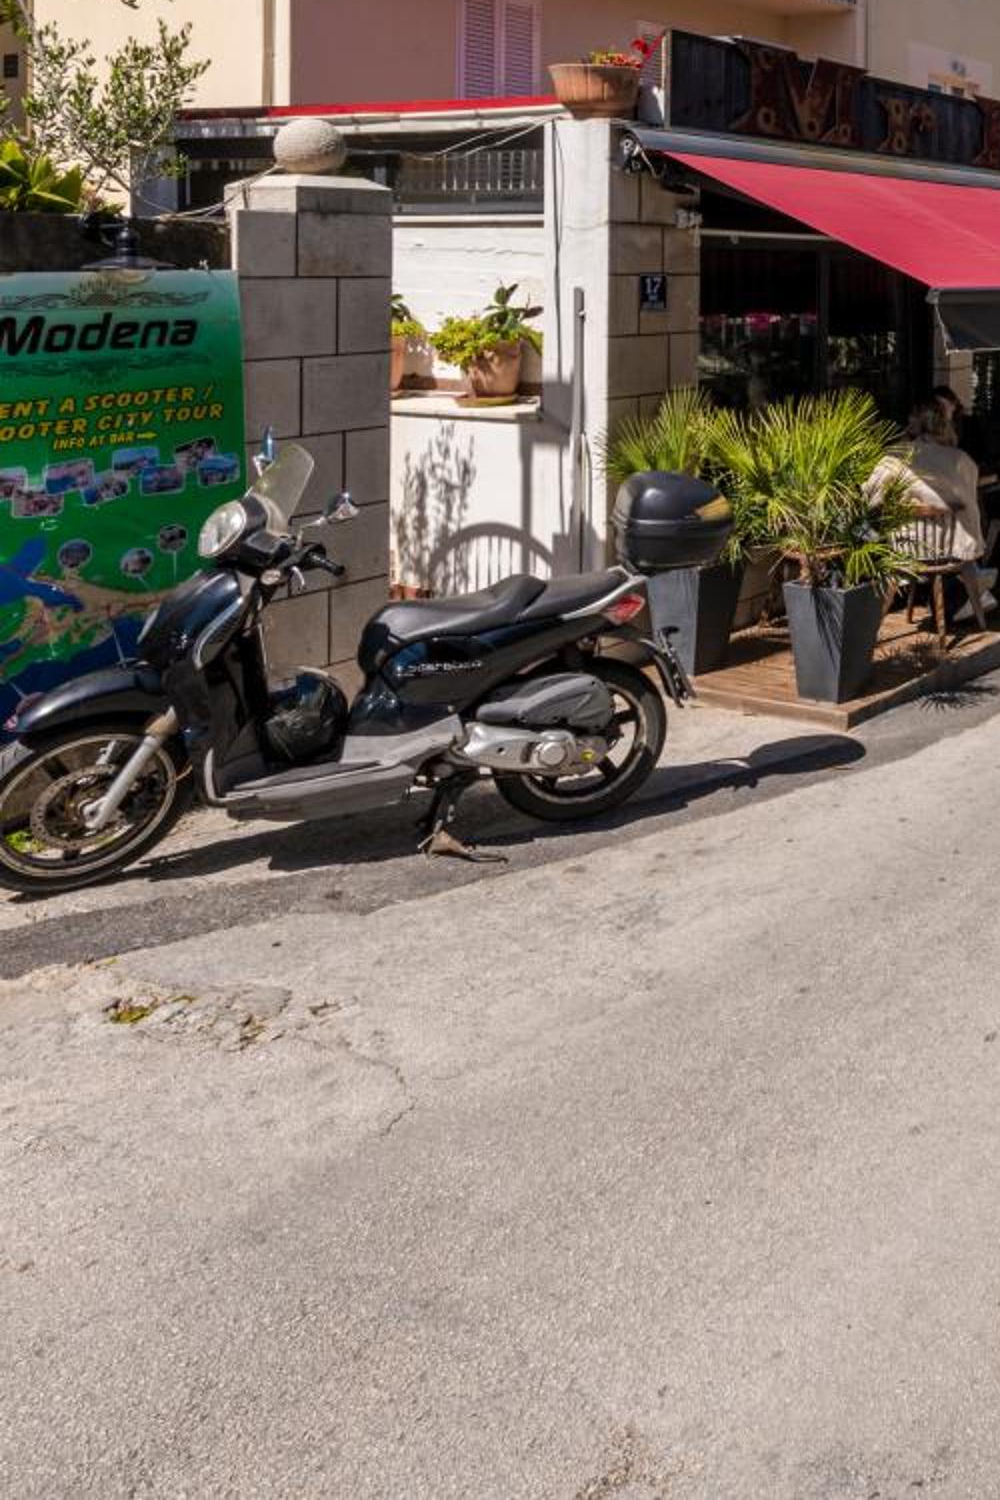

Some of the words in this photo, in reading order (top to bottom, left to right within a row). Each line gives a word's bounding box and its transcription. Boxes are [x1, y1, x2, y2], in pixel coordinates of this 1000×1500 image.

[728, 38, 944, 154] Mr
[645, 277, 661, 293] 17
[0, 312, 198, 356] Modena
[59, 398, 75, 413] A
[84, 387, 195, 411] SCOOTER
[96, 411, 153, 431] CITY
[163, 404, 224, 422] TOUR
[53, 436, 84, 450] INFO
[89, 434, 105, 448] AT
[109, 431, 135, 443] BAR
